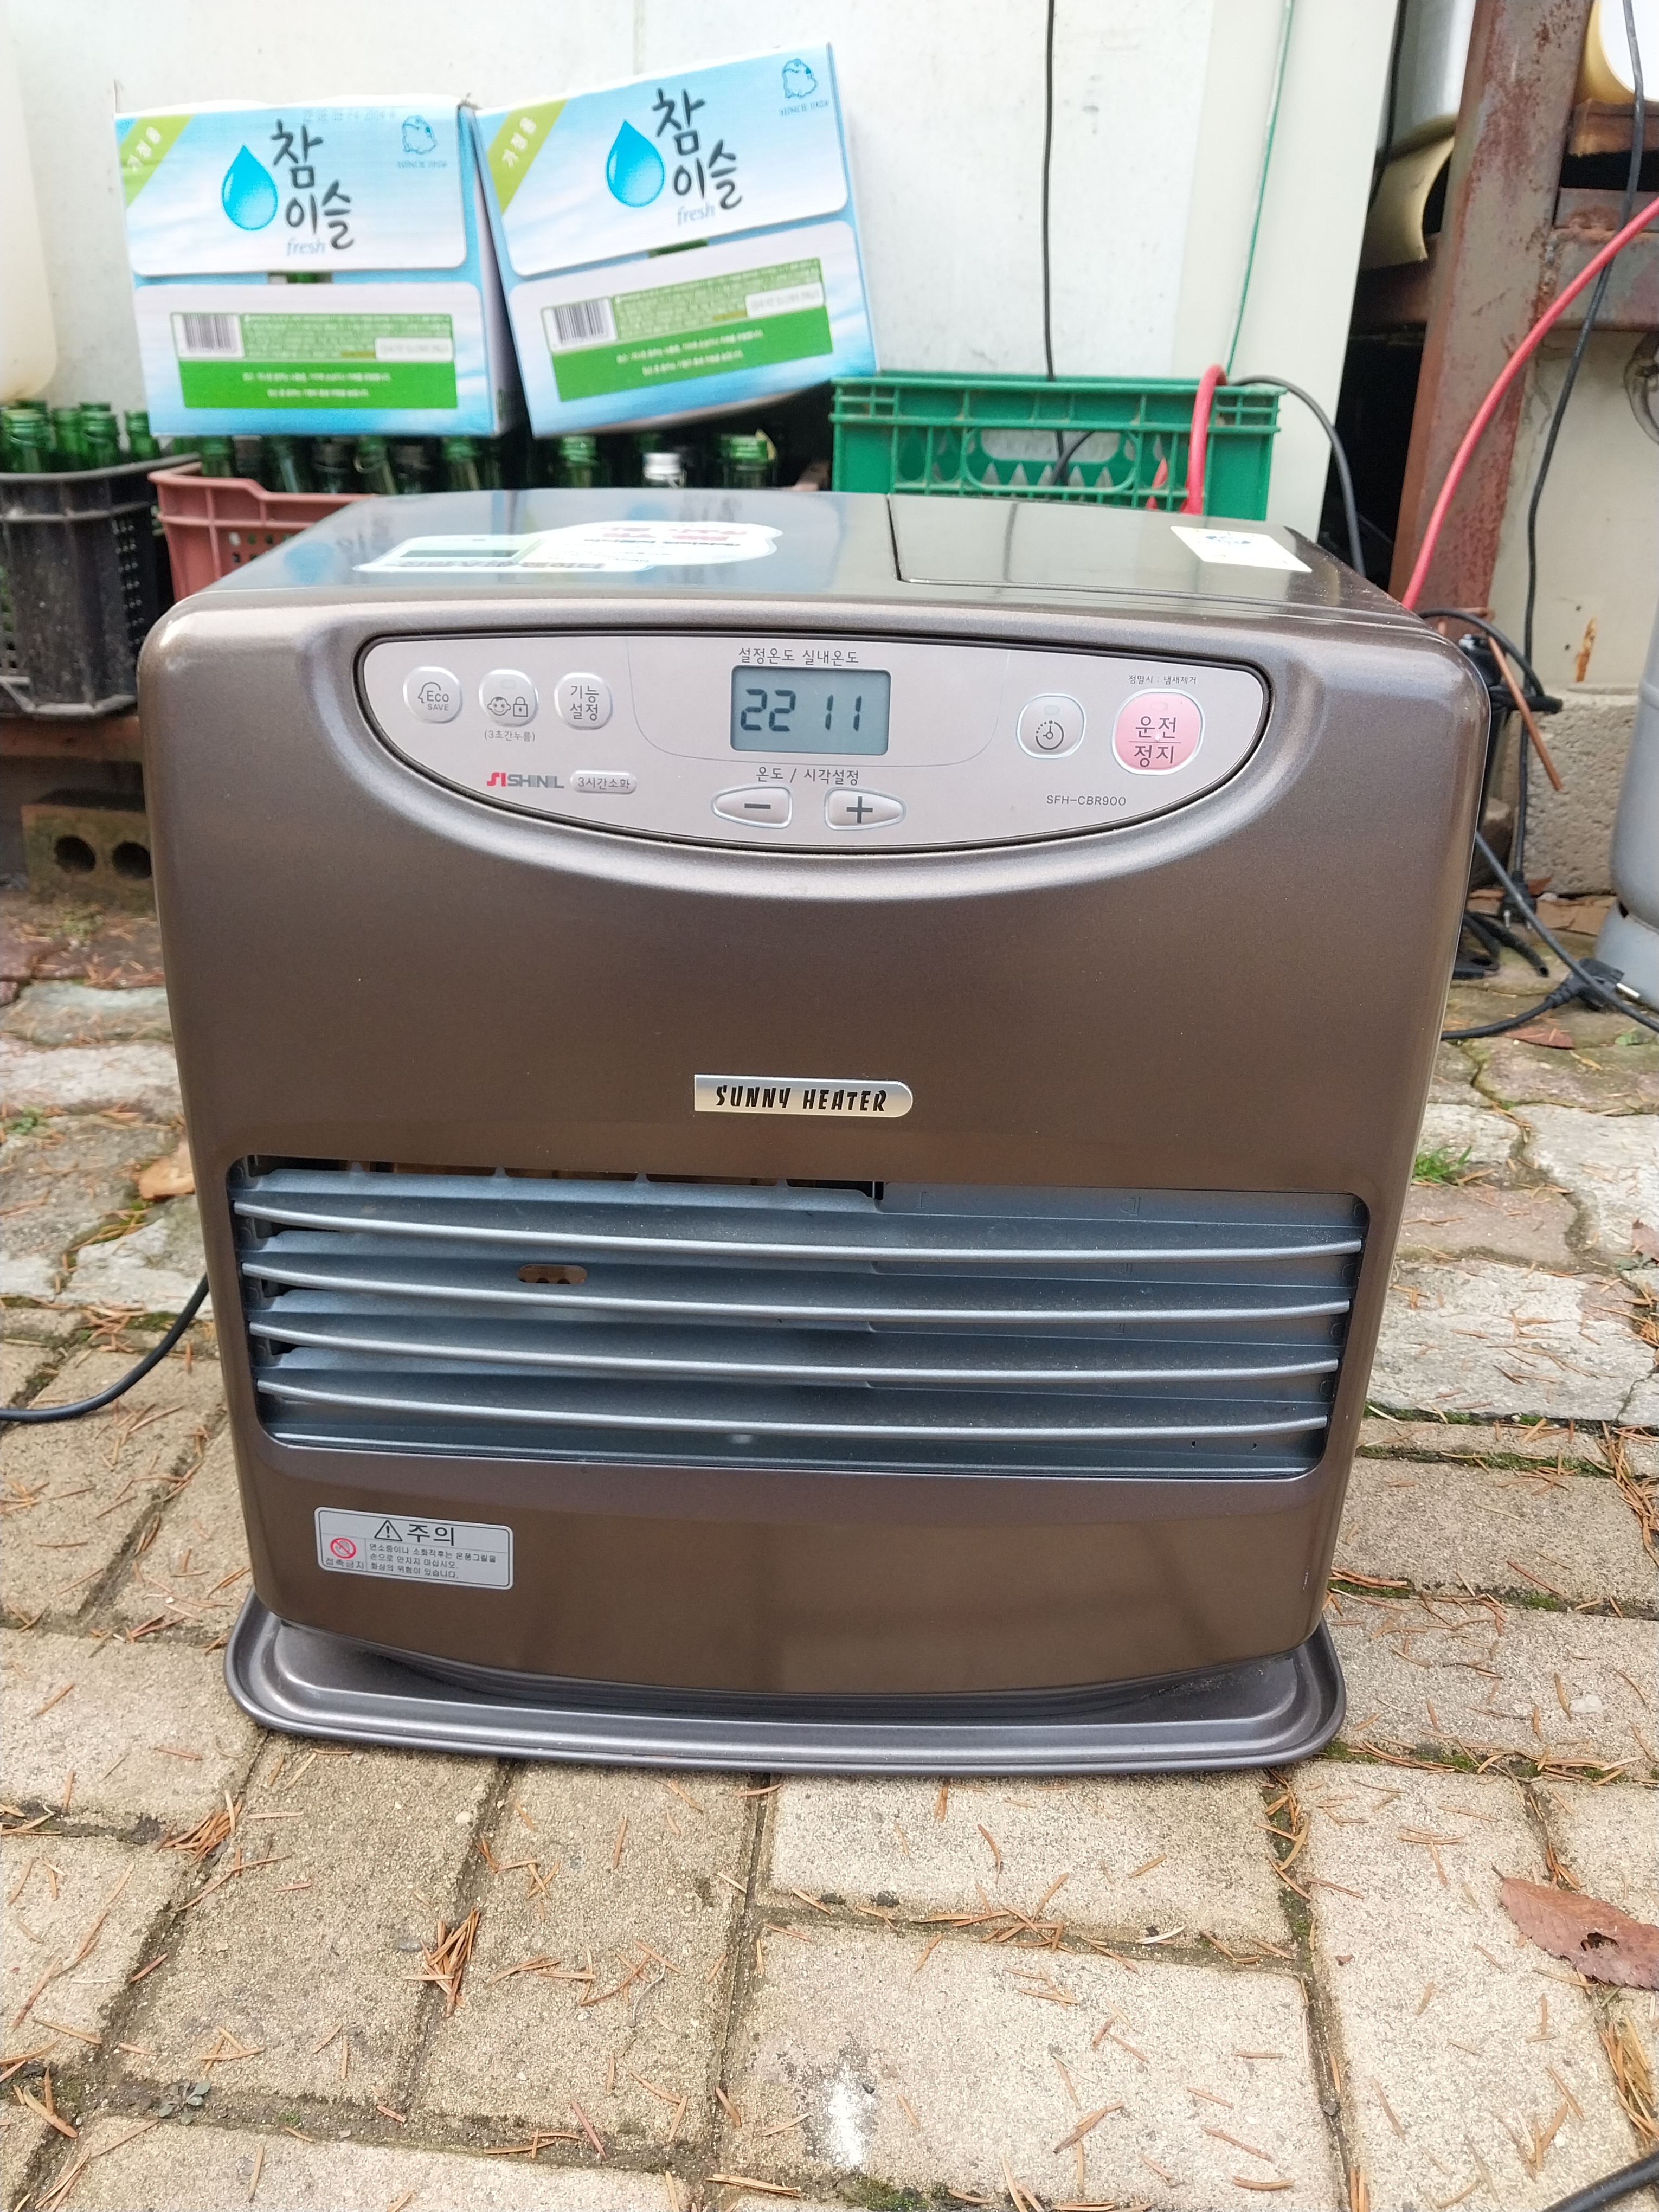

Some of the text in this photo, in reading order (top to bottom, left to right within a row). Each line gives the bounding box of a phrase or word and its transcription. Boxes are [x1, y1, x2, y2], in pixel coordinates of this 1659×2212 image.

[677, 202, 715, 225] fresh
[286, 238, 326, 256] fresh
[738, 647, 859, 666] 설정온도 실내온도
[1129, 675, 1153, 684] 점멸시
[1164, 676, 1197, 685] 냄새제거
[427, 689, 449, 702] Eco
[569, 684, 600, 703] 기능
[427, 703, 449, 711] SAVE
[569, 704, 600, 721] 설정
[740, 688, 862, 732] 22 11
[484, 730, 536, 743] (3초간누름)
[1135, 716, 1177, 740] 운전
[1134, 745, 1174, 767] 정지
[577, 776, 630, 789] 3시간소화
[756, 767, 783, 782] 온도
[803, 769, 859, 785] 시각설정
[1046, 795, 1126, 806] SFH-CBR900
[716, 1084, 888, 1112] SUNNY HEATER
[407, 1523, 455, 1547] 주의
[370, 1544, 496, 1563] 연소중이나 소화직후는 온풍그릴을
[370, 1553, 458, 1568] 손으로 만지지 마십시오.
[325, 1558, 364, 1570] 접촉금지
[371, 1562, 393, 1571] 화상의
[424, 1569, 459, 1578] 있습니다.
